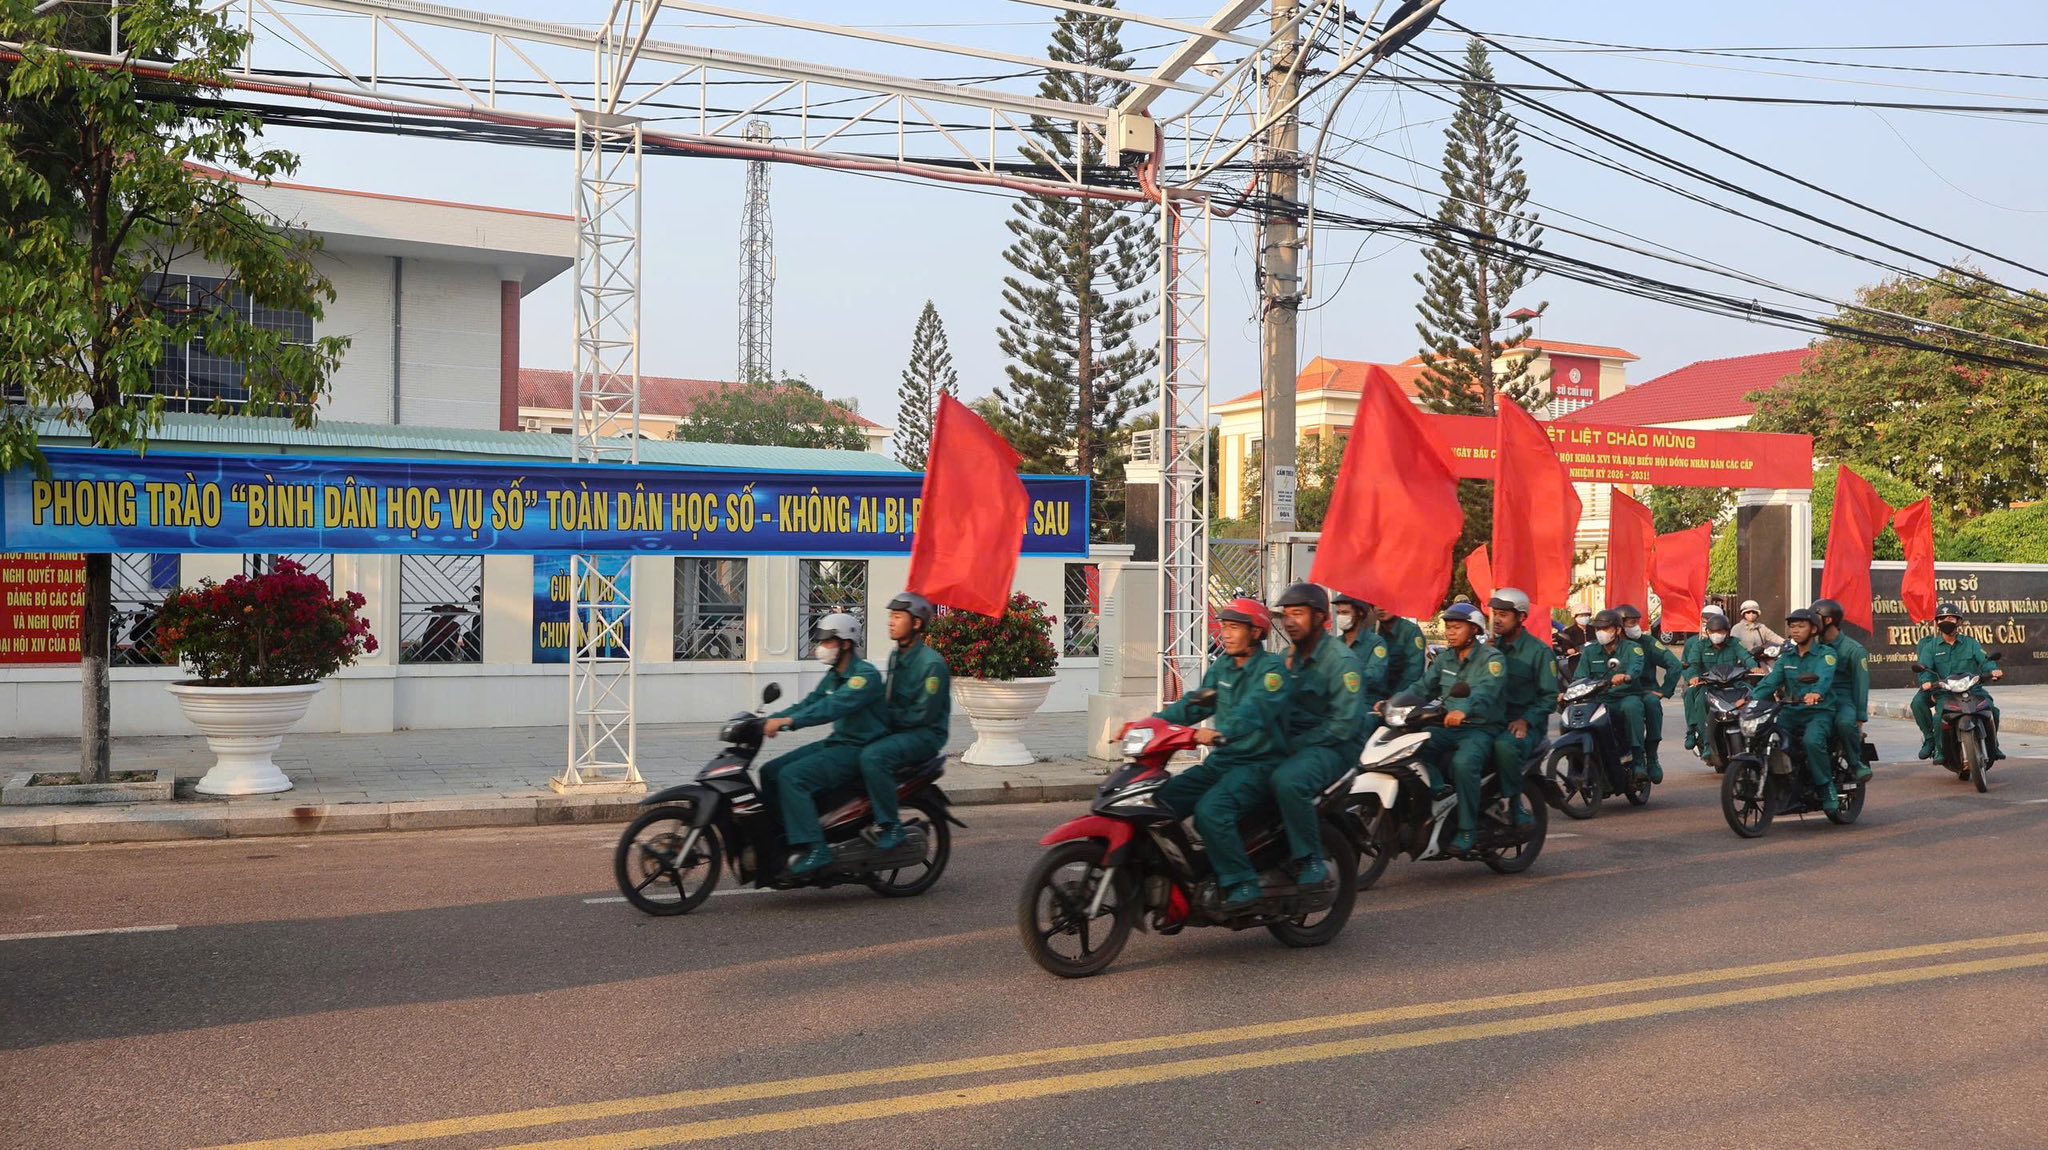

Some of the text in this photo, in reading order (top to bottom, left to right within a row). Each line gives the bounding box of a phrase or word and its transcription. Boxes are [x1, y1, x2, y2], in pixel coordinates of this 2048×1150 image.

[1571, 427, 1602, 446] LIỆT
[1607, 429, 1649, 447] CHÀO
[1653, 431, 1696, 449] MỪNG
[1559, 451, 1573, 465] HỘI
[1597, 454, 1610, 464] XVI
[1623, 455, 1635, 467] ĐẠI
[1655, 455, 1668, 468] HỘI
[1607, 470, 1624, 479] 2026
[1631, 471, 1650, 480] 2031!
[32, 479, 137, 526] PHONG
[145, 472, 222, 527] TRÀO
[324, 475, 377, 529] DÂN
[387, 486, 441, 539] HỌC
[448, 487, 483, 539] VỤ
[546, 481, 609, 532] TOÀN
[617, 482, 663, 532] DÂN
[671, 493, 718, 541] HỌC
[726, 482, 756, 533] SỐ
[779, 486, 851, 533] KHÔNG
[857, 497, 877, 533] AI
[885, 498, 905, 542] BỊ
[1033, 500, 1070, 536] SAU
[3, 564, 87, 586] NGHỊ QUYẾT ĐẠI HỘ
[1960, 573, 1978, 591] SỞ
[7, 586, 32, 606] ĐẢNG
[35, 588, 47, 609] BỘ
[49, 588, 68, 606] CÁC
[584, 575, 616, 602] NAU
[1872, 595, 1898, 613] ỒNG
[1970, 595, 1985, 613] ỦY
[1988, 600, 2010, 613] BAN
[2011, 597, 2039, 613] NHÂN
[13, 610, 80, 632] VÀ NGHỊ QUYẾT
[1887, 621, 1938, 645] PHƯỜ
[1998, 616, 2026, 644] CẦU
[0, 633, 81, 655] ẠI HỘI XIV CỦA ĐẢ
[539, 621, 585, 648] CHUYN
